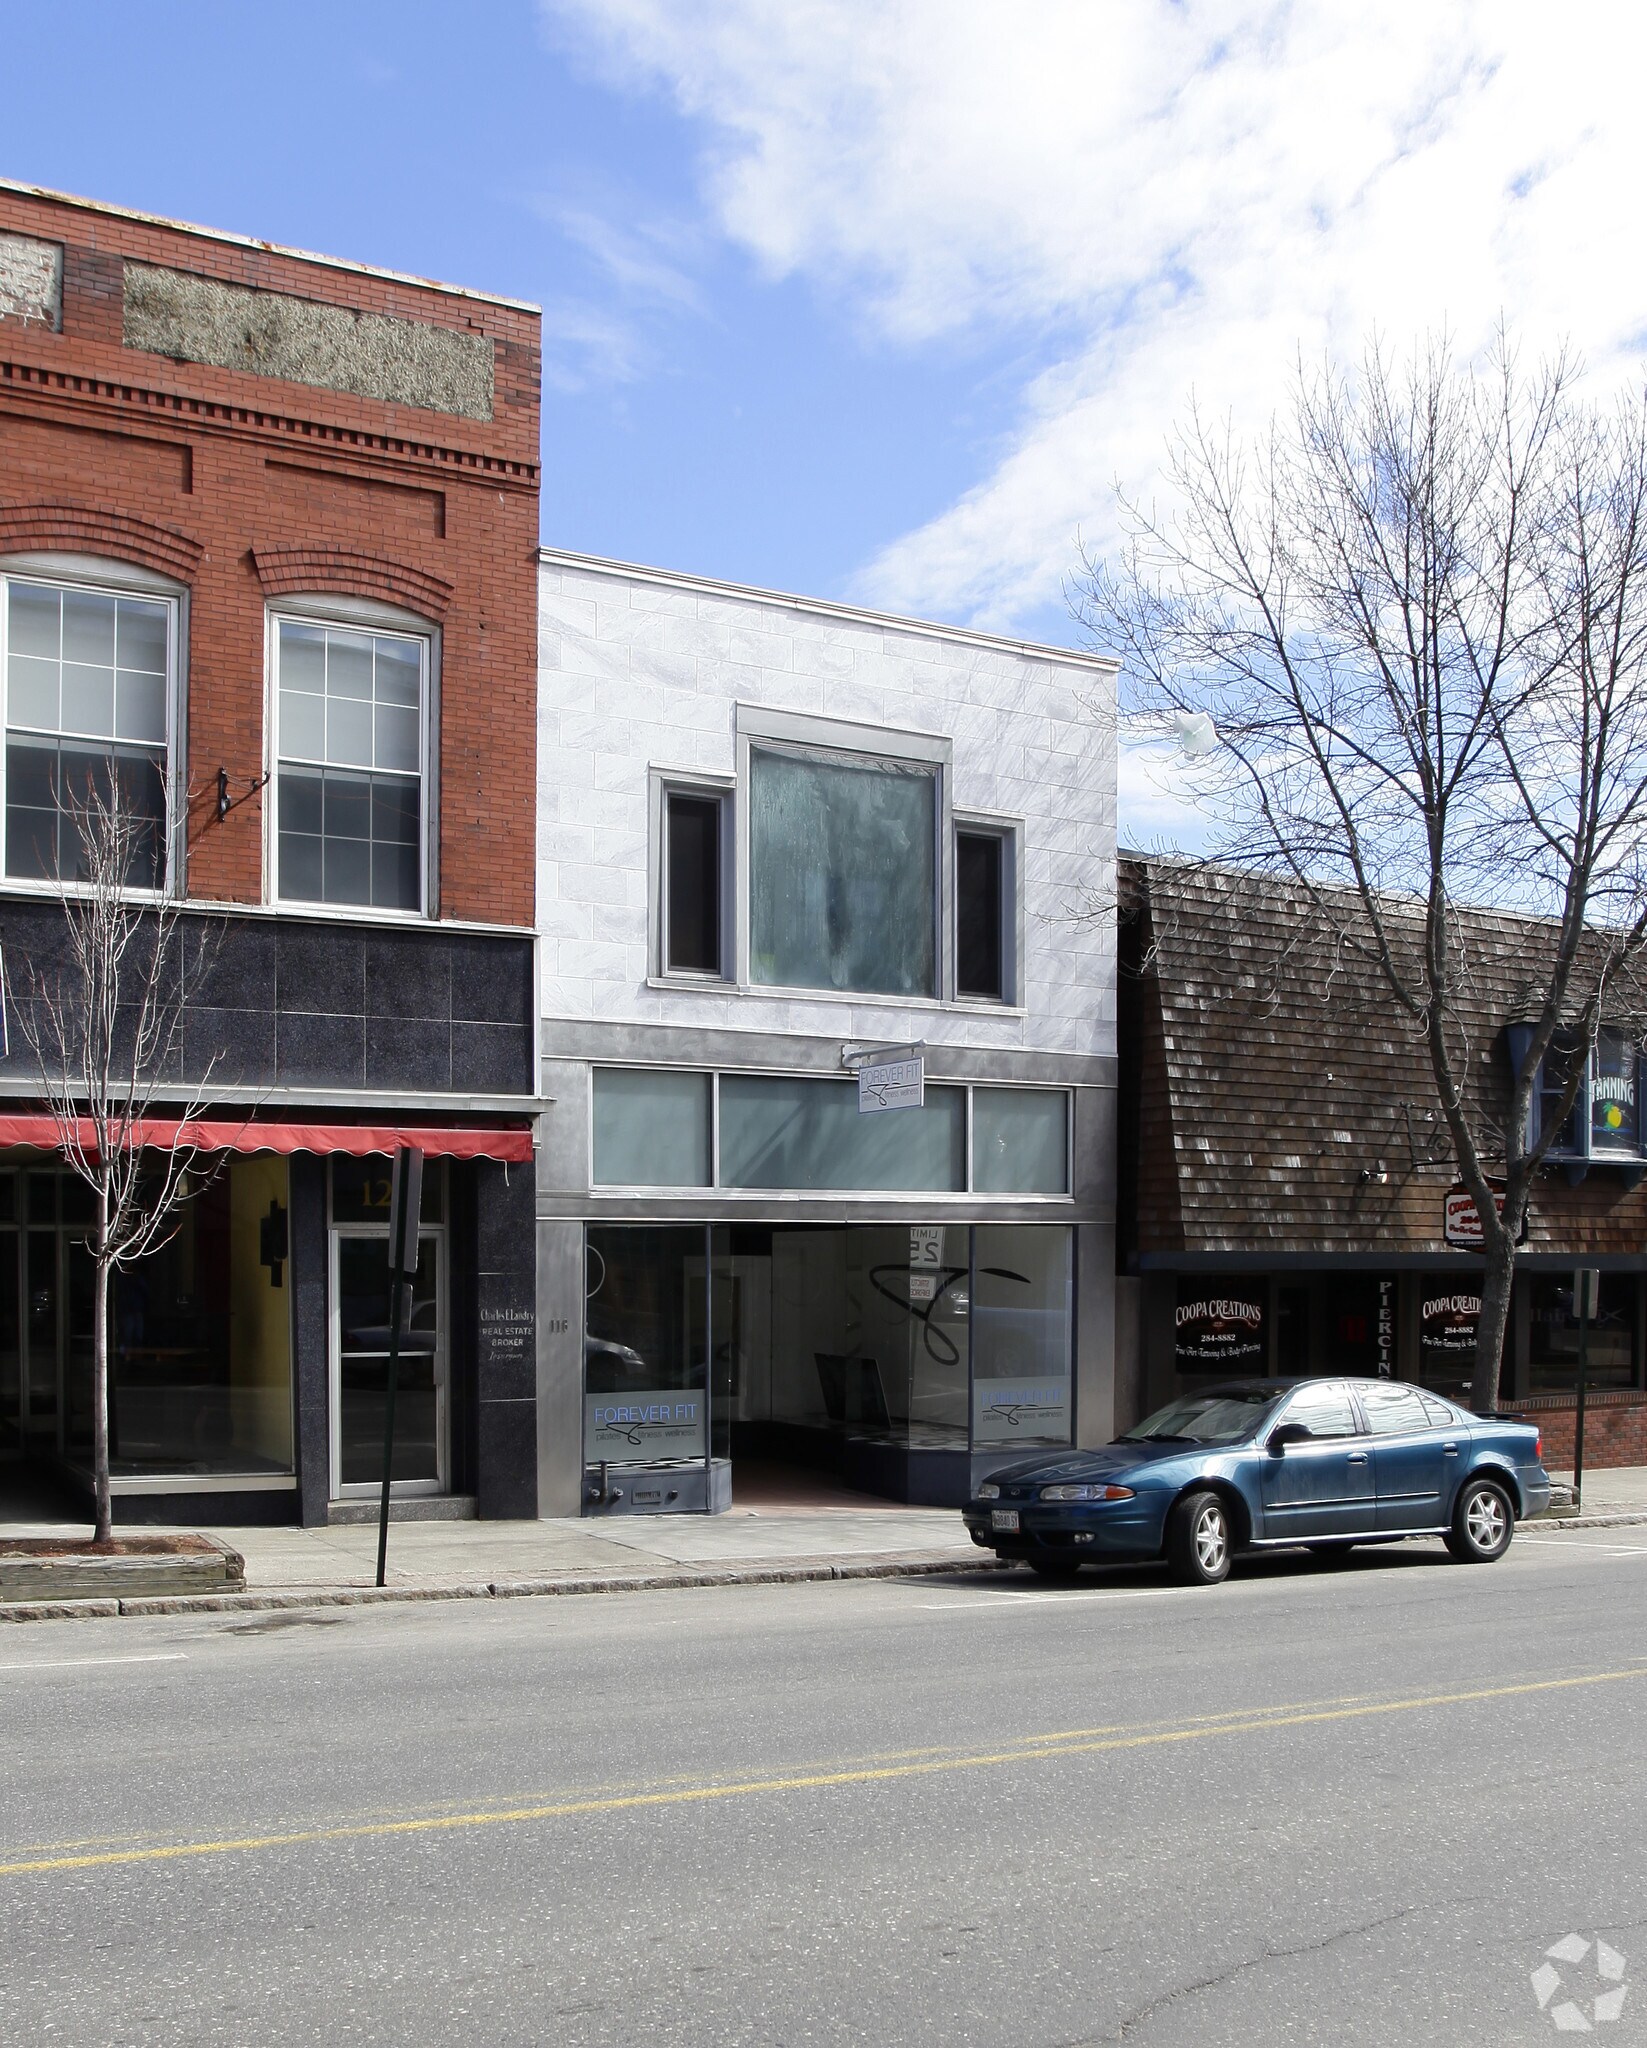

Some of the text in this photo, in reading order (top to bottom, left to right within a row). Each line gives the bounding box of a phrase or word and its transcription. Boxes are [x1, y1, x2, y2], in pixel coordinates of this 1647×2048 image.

[861, 1063, 919, 1085] FOREVER FIT
[1590, 1077, 1634, 1106] TANNING
[1175, 1300, 1261, 1328] COOPA CREATIONS
[1422, 1295, 1481, 1319] COOPA CREATI
[506, 1327, 533, 1335] ESTATE
[1201, 1334, 1236, 1342] 284-8882
[1378, 1282, 1392, 1380] PIERCIN
[492, 1339, 523, 1347] BROKER
[1220, 1347, 1226, 1357] &
[594, 1404, 698, 1423] FOREVER FIT
[596, 1427, 696, 1442] pilates fitness wellness
